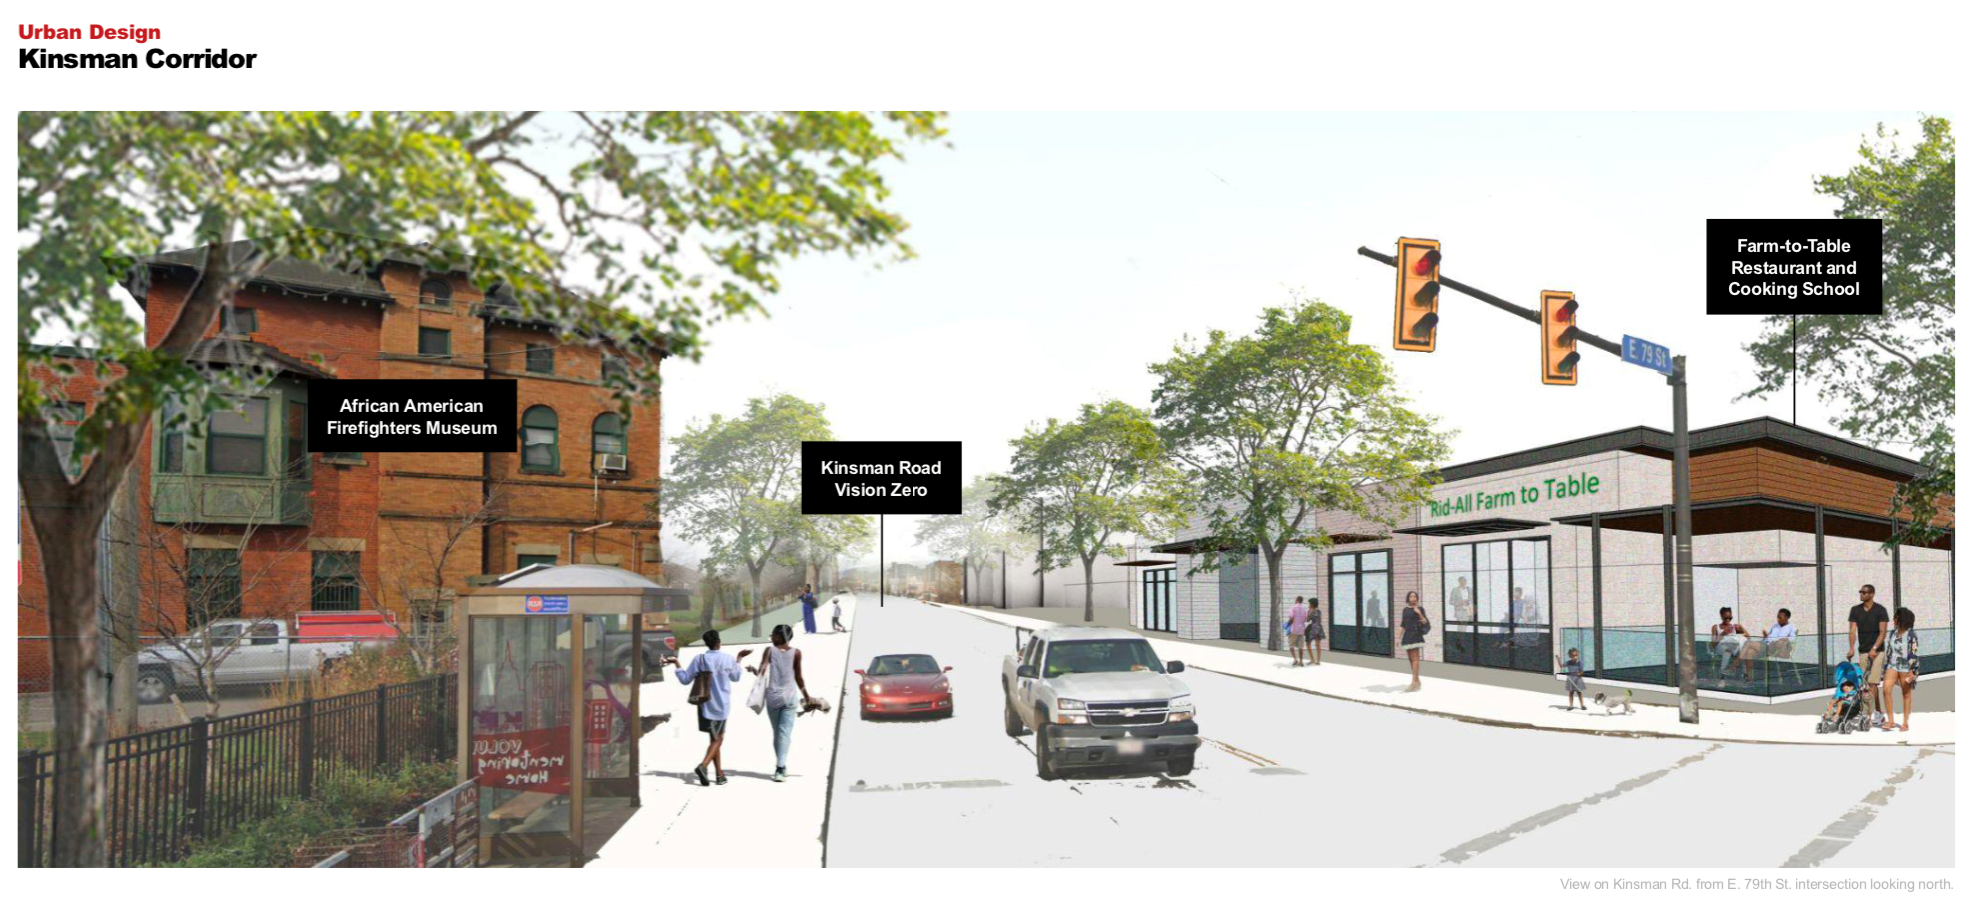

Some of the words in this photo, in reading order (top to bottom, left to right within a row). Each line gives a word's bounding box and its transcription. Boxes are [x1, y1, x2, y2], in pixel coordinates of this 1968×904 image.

[1642, 343, 1653, 364] 79
[1655, 347, 1666, 368] St
[1431, 494, 1472, 517] Rid-All
[1476, 490, 1515, 511] Farm
[1520, 486, 1539, 504] to
[1543, 472, 1600, 500] Table
